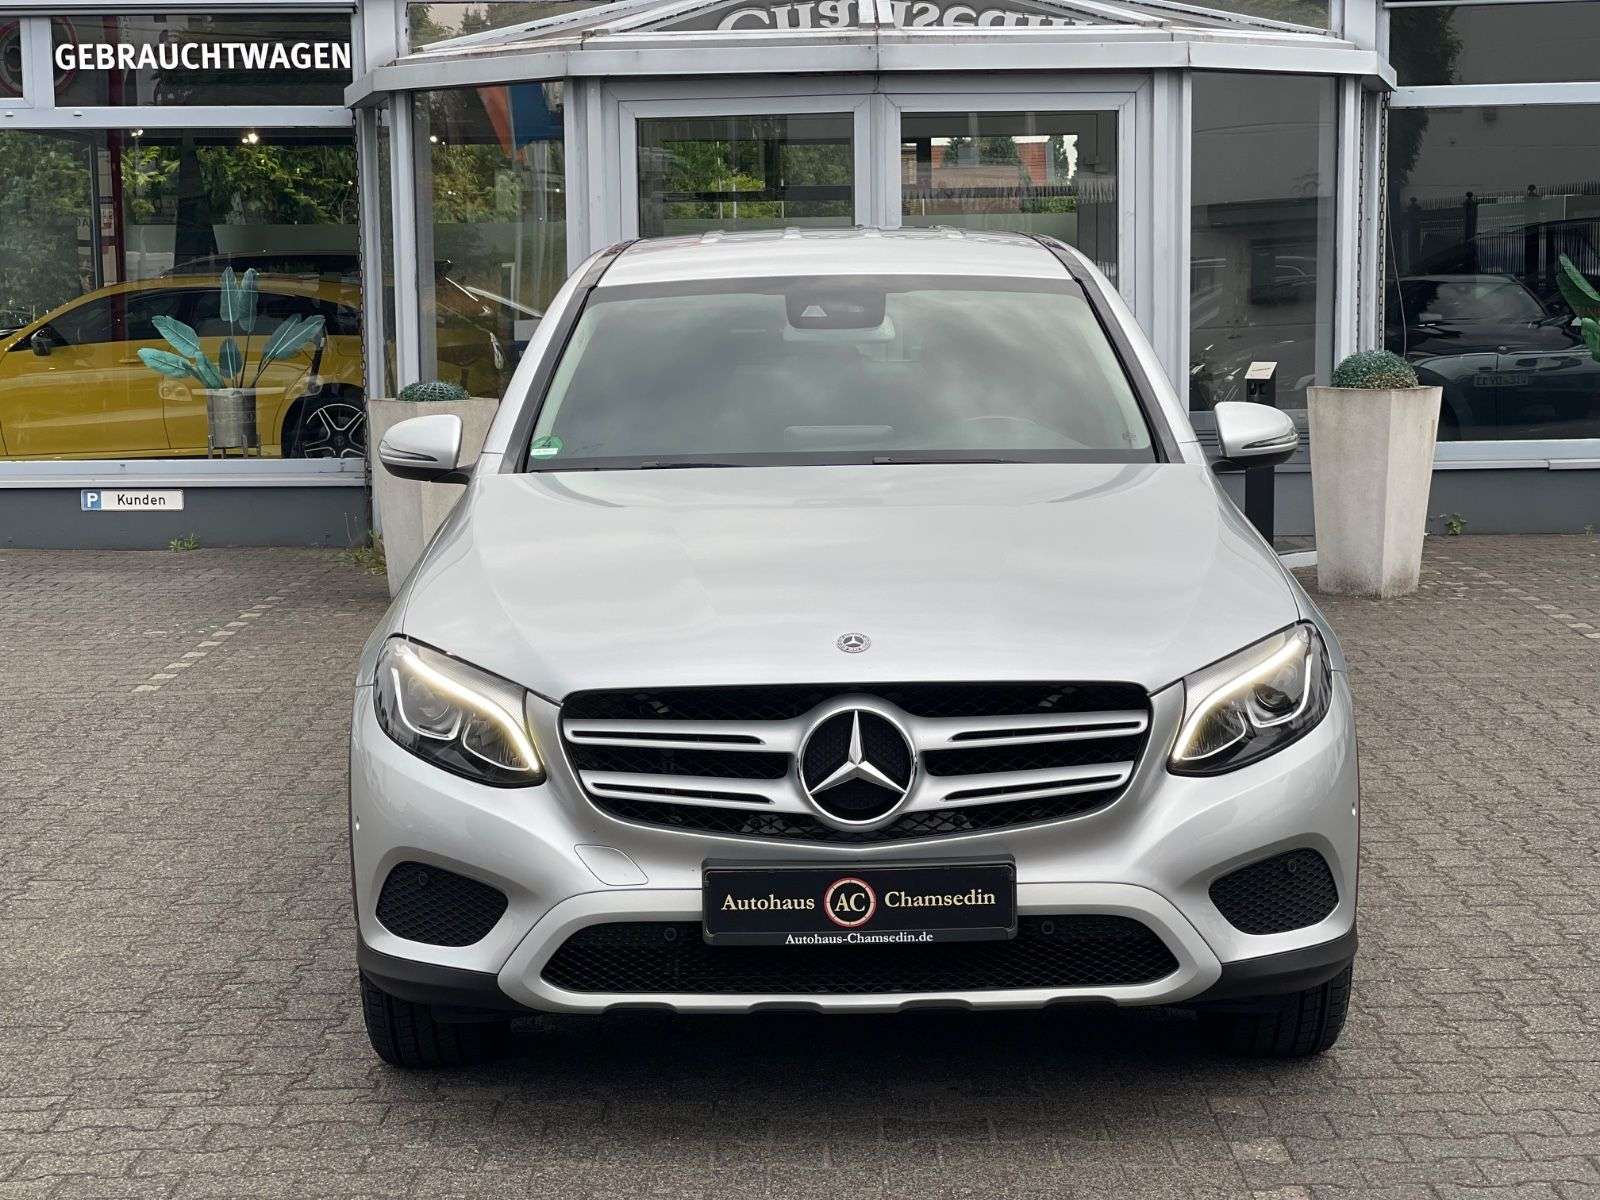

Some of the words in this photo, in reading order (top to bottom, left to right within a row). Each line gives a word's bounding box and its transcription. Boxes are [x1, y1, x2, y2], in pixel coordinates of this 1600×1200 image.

[55, 43, 351, 70] GEBRAUCHTWAGEN
[87, 492, 98, 507] P
[117, 494, 166, 505] Kunden
[721, 894, 815, 911] Autohaus
[834, 892, 866, 912] AC
[884, 889, 996, 908] Chamsedin
[785, 931, 934, 945] Autohaus-Chamsedin.de
